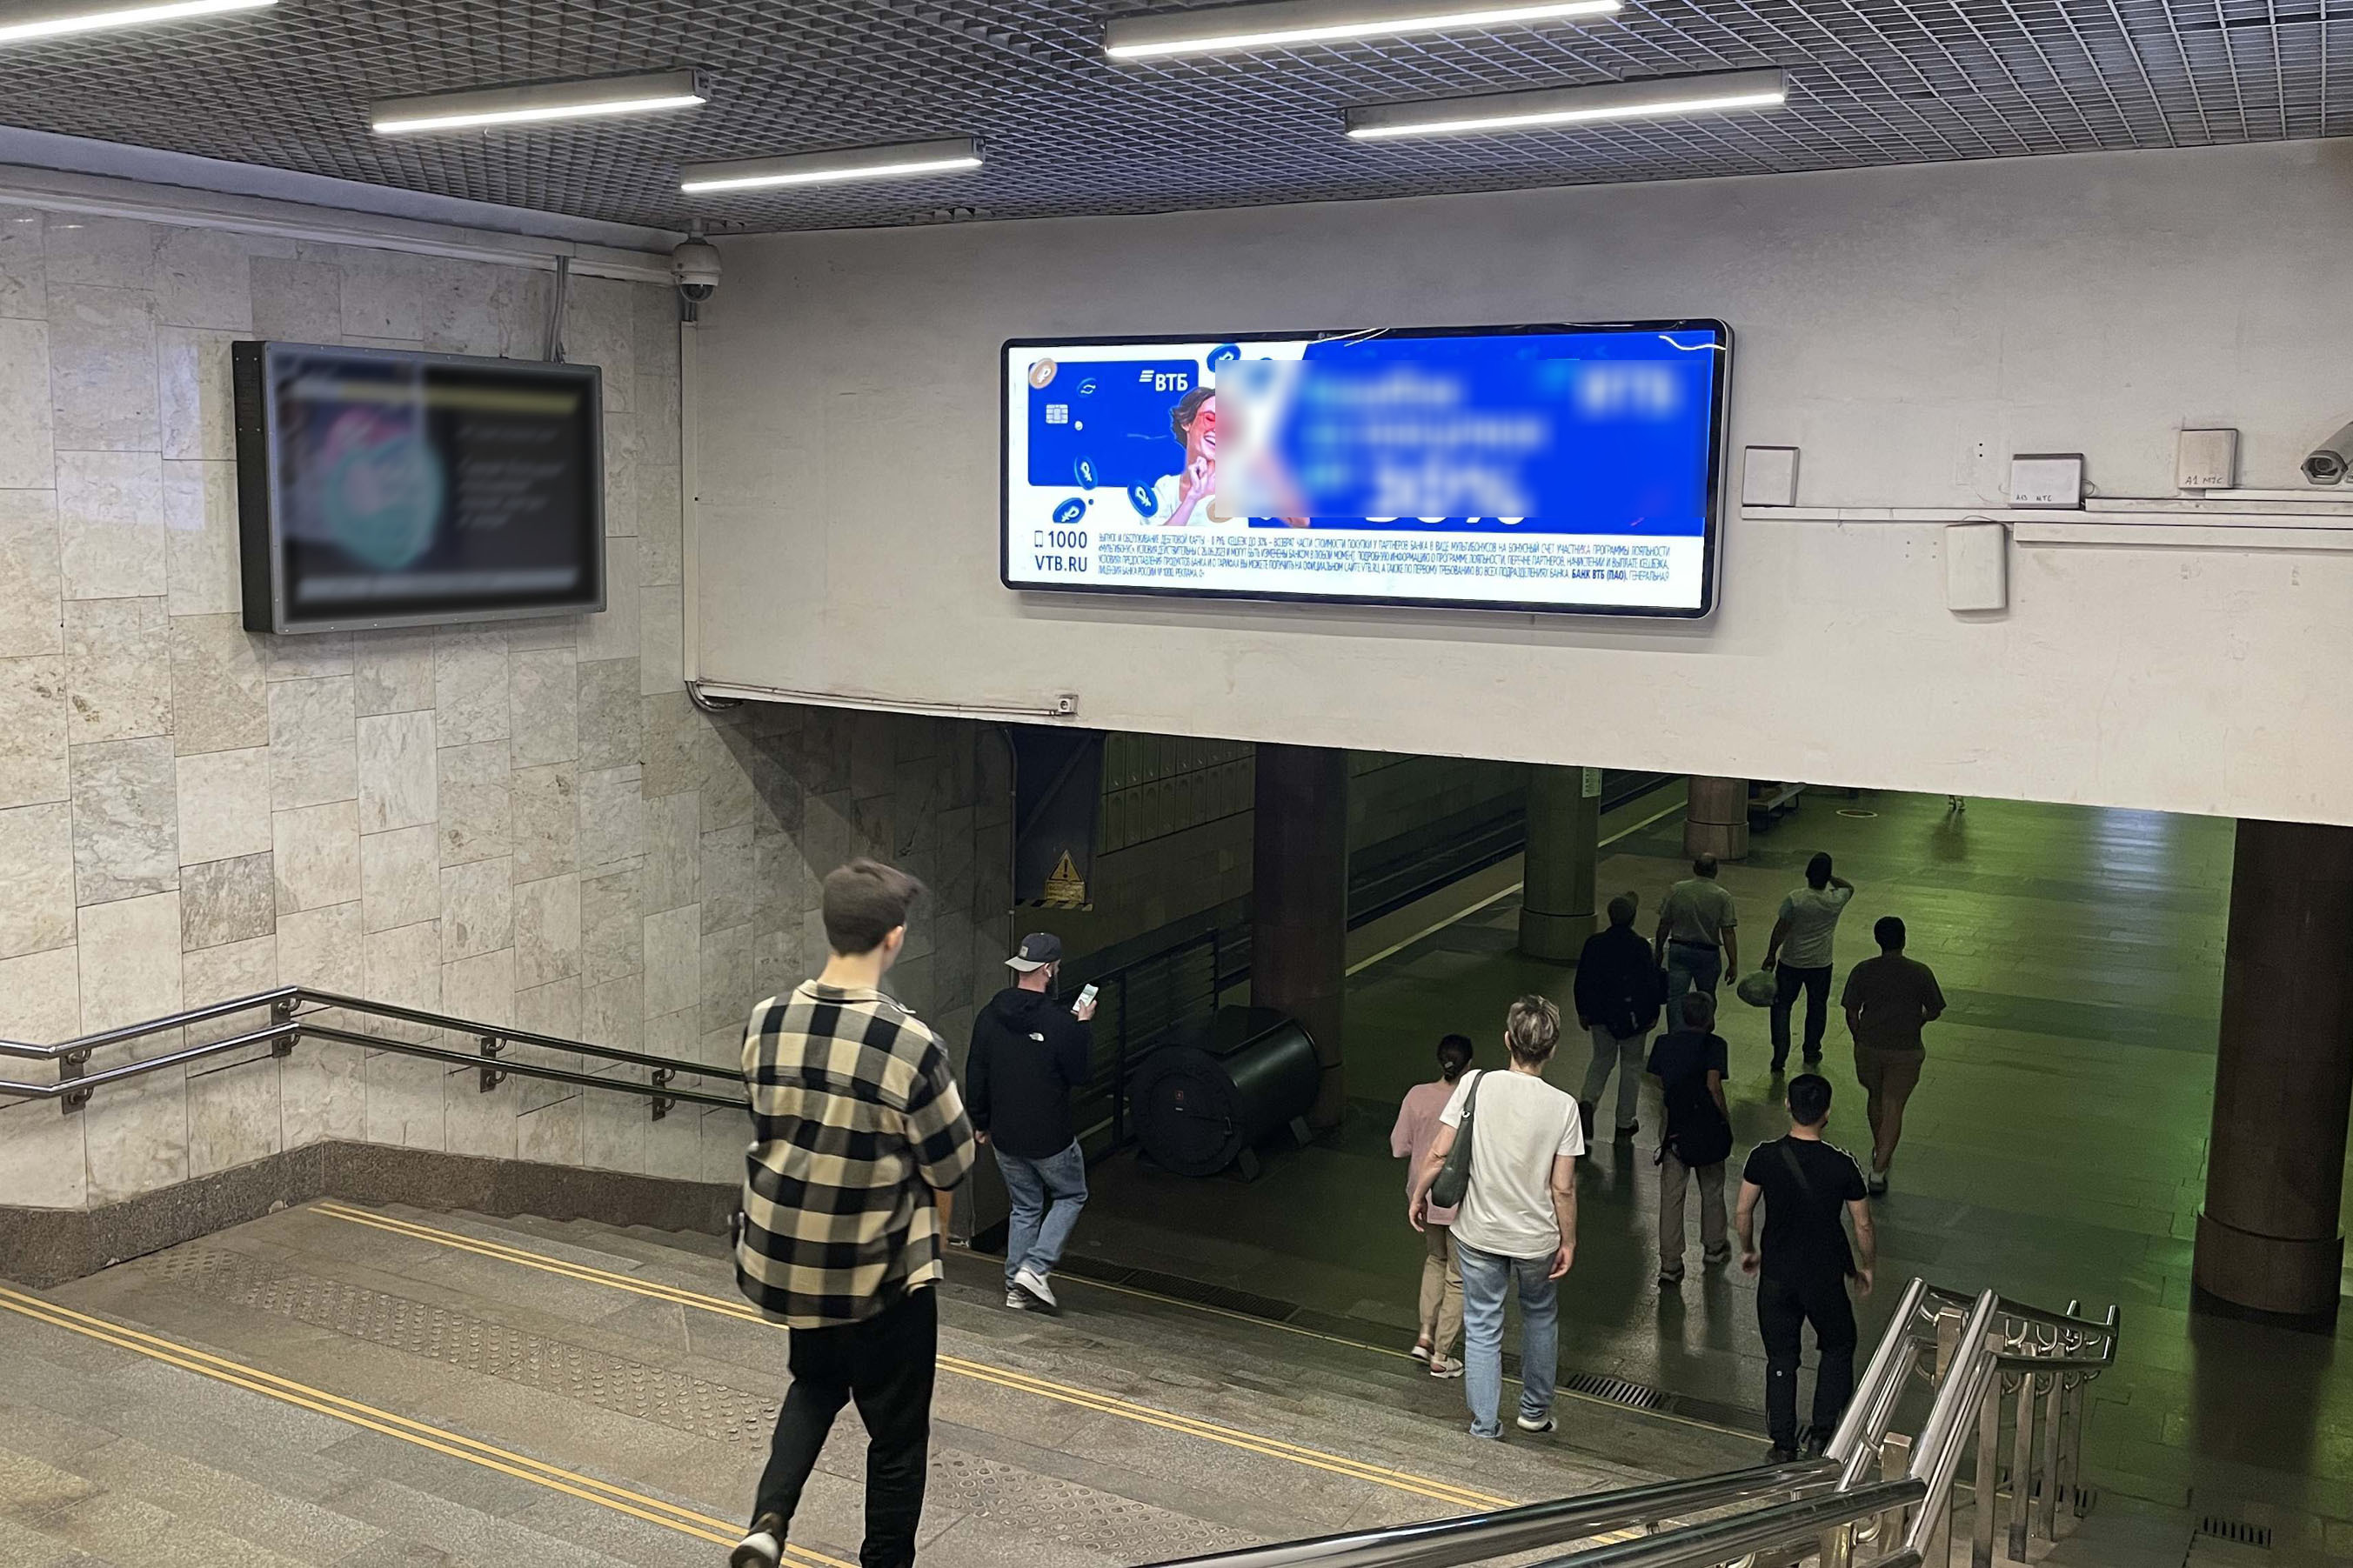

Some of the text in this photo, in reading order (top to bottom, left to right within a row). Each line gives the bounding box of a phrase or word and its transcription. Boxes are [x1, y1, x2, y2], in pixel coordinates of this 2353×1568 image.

[1155, 373, 1188, 391] ВТБ
[1048, 530, 1087, 549] 1000
[1034, 555, 1087, 572] VTB.RU
[1572, 568, 1591, 578] БАНК
[1592, 569, 1605, 579] ВТБ
